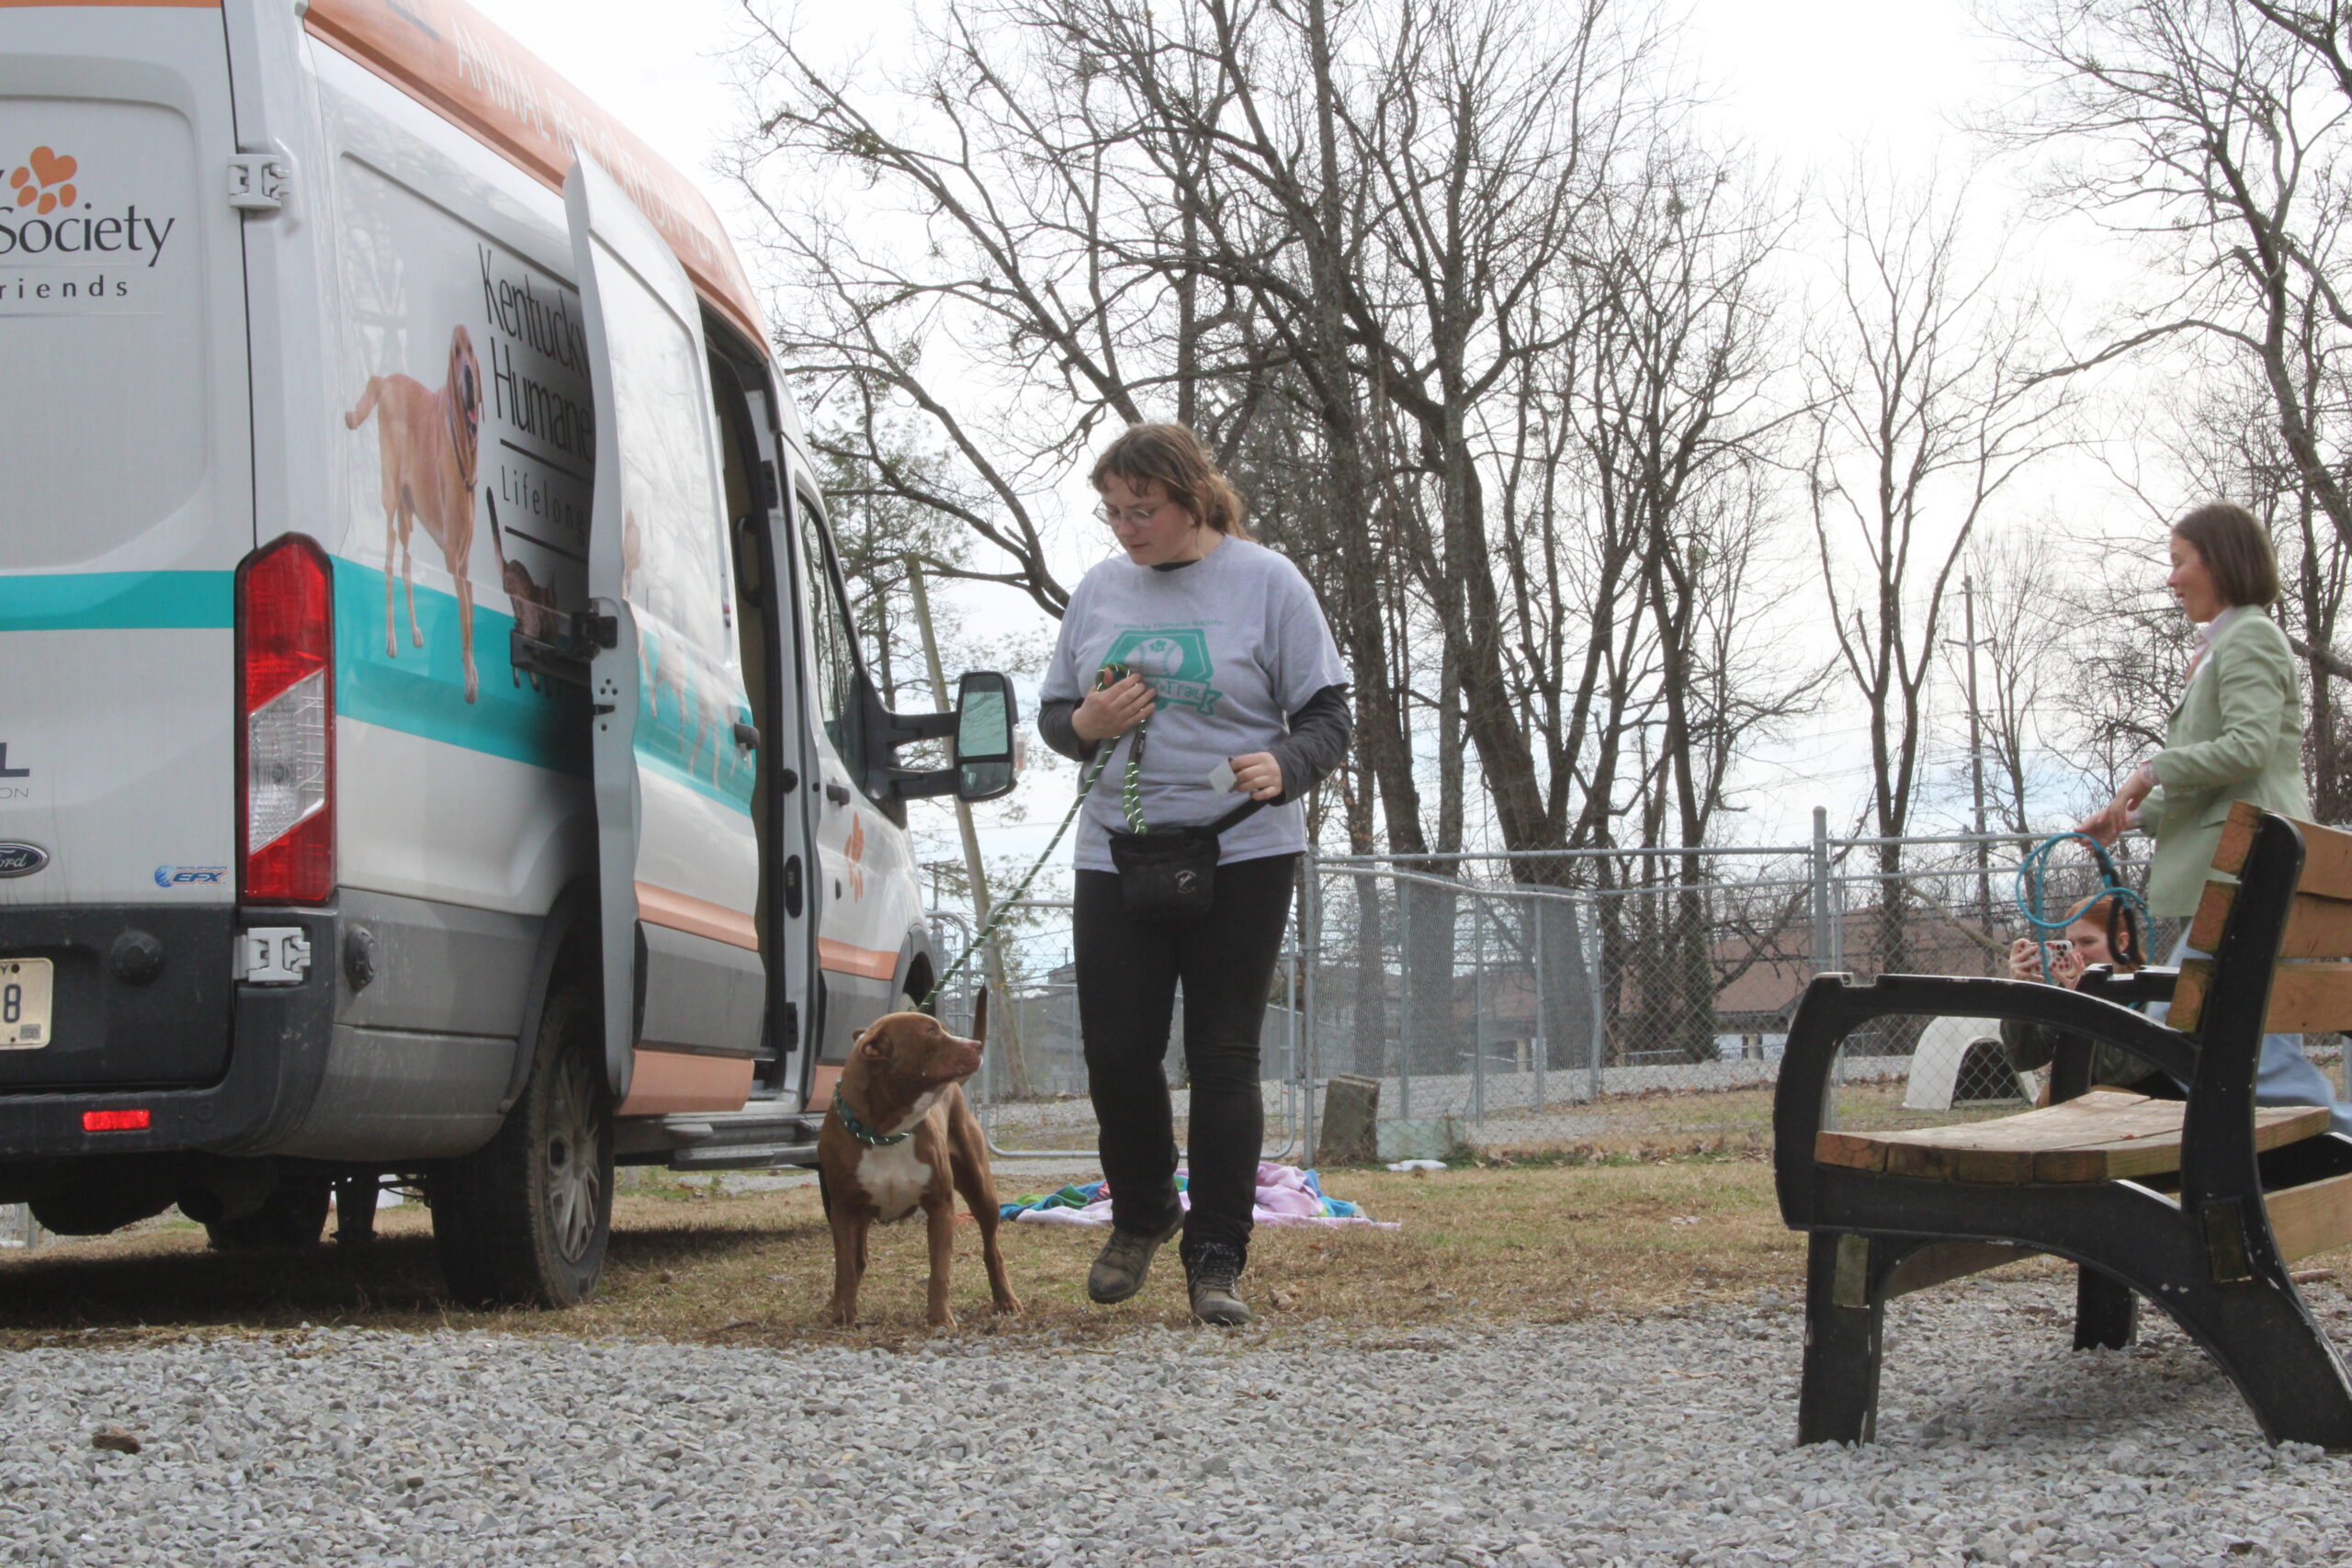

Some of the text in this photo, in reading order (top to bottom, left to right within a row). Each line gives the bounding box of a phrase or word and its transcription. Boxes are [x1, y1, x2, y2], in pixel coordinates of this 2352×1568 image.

[450, 17, 551, 142] ANIMAL
[491, 336, 593, 462] Humane
[502, 465, 585, 546] Lifelong
[173, 872, 224, 883] EFX
[4, 984, 21, 1023] 8
